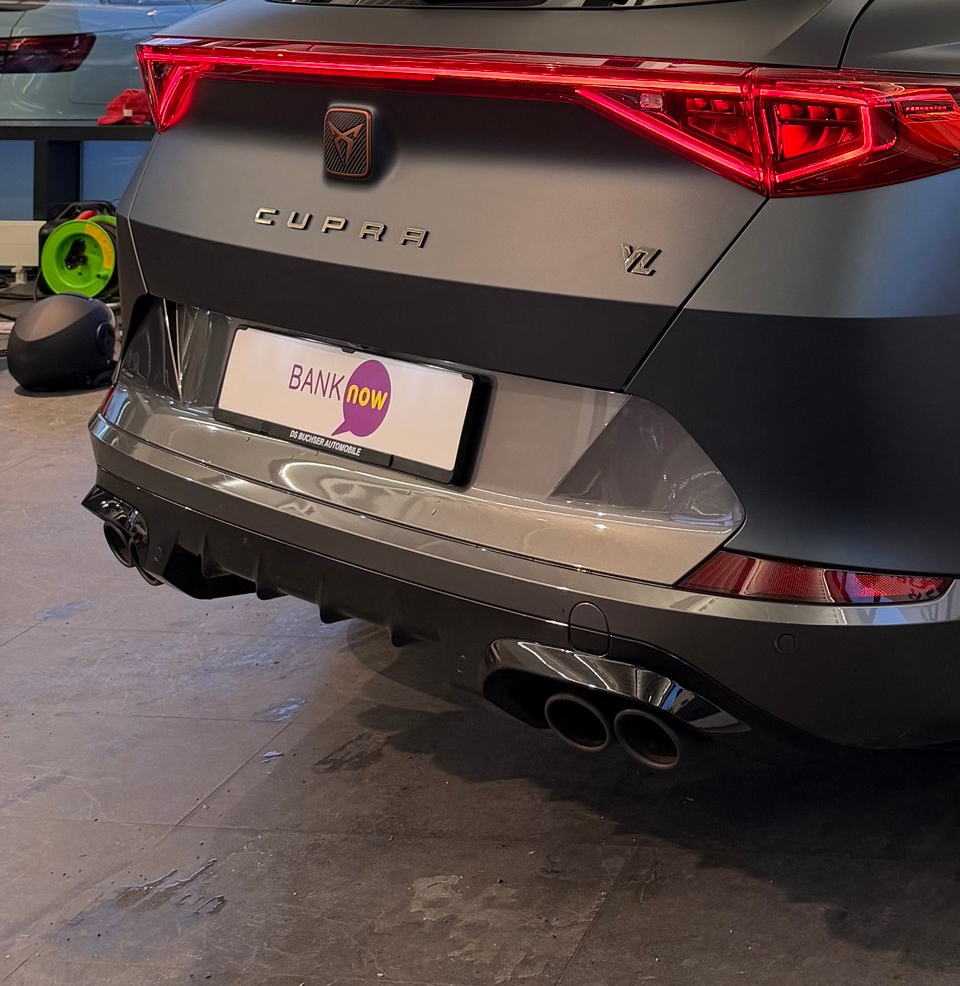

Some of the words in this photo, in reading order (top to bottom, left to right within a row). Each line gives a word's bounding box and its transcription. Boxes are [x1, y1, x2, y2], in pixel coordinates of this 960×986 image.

[254, 207, 430, 248] CUPRA
[288, 364, 345, 401] BANK
[346, 384, 388, 410] now
[289, 430, 298, 440] DS
[298, 432, 324, 446] BUCHSER
[325, 439, 362, 456] AUTOMOBILE
